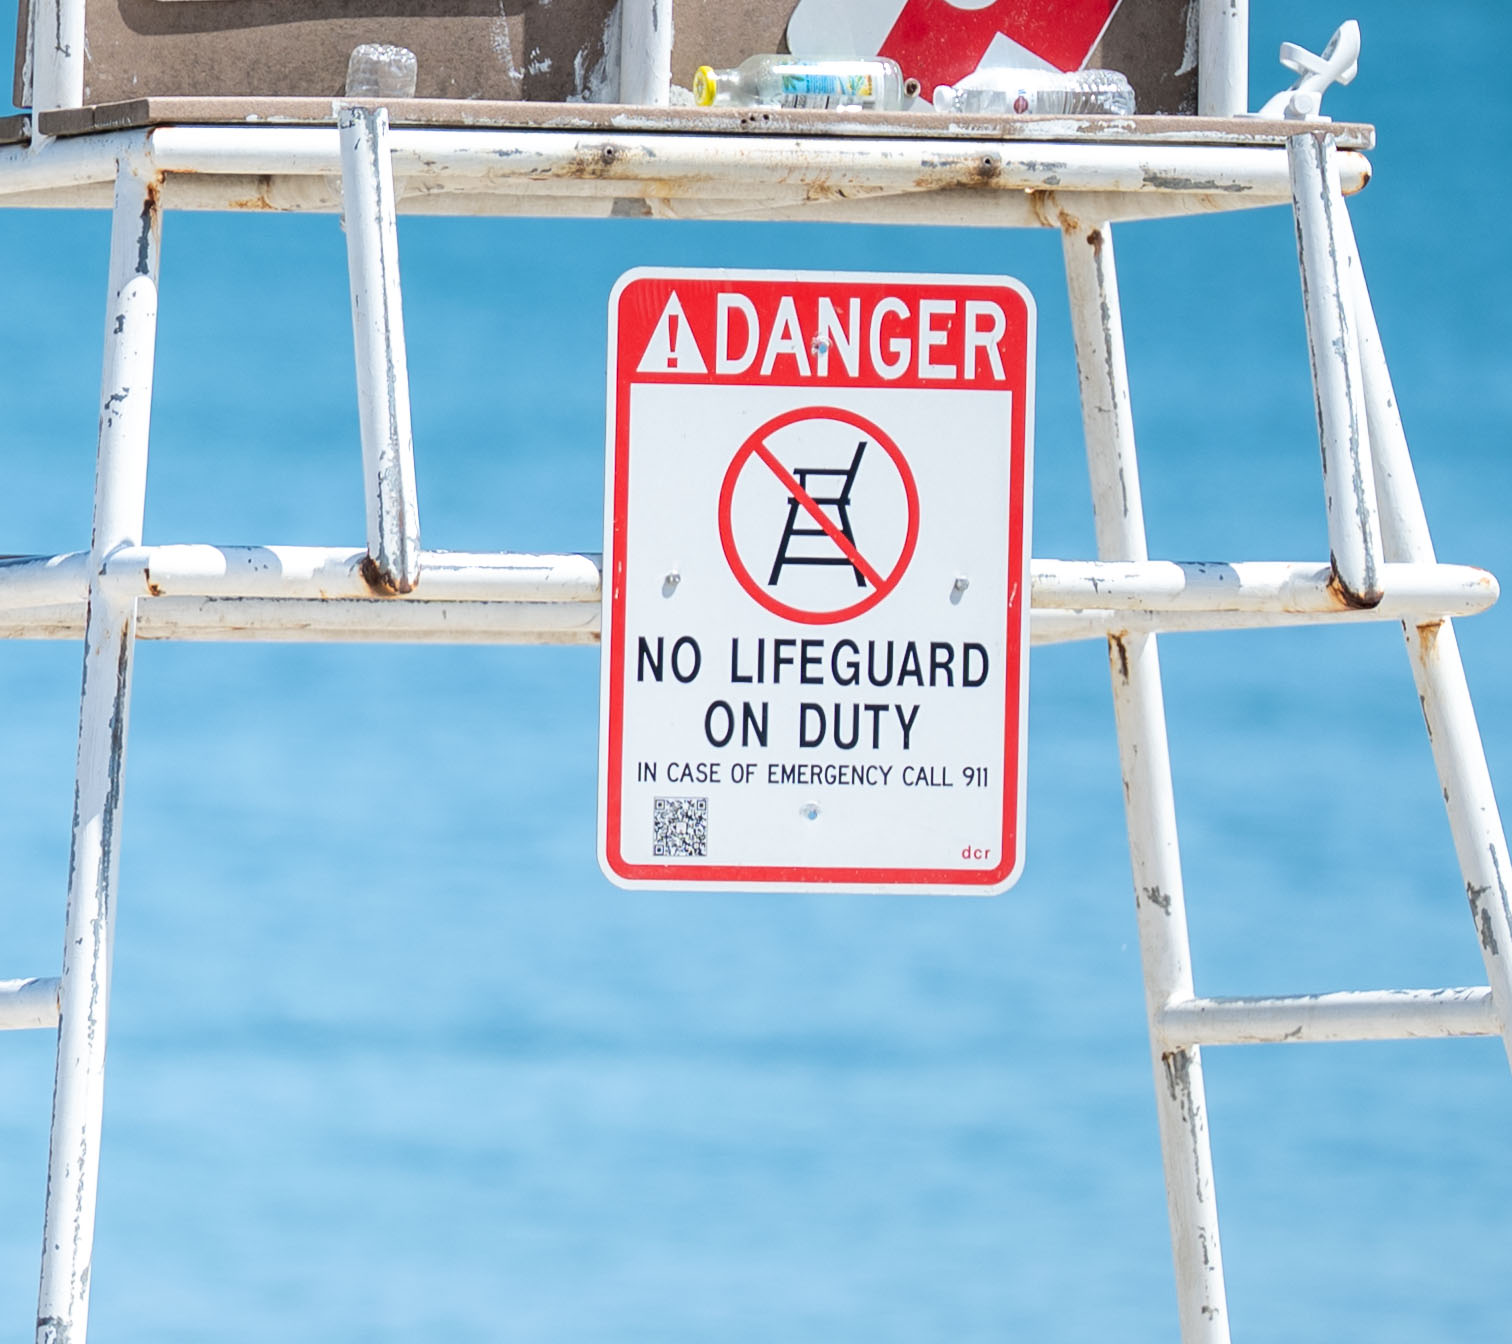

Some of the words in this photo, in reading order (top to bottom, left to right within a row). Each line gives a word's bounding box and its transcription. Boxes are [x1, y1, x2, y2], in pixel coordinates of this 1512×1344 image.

[714, 291, 1008, 381] DANGER
[637, 635, 702, 684] NO
[731, 637, 989, 688] LIFEGUARD
[704, 700, 769, 748] ON
[799, 702, 920, 750] DUTY
[638, 762, 657, 782] IN
[667, 762, 721, 783] CASE
[731, 763, 758, 784] OF
[768, 763, 893, 786] EMERGENCY
[902, 765, 953, 787] CALL
[962, 766, 988, 787] 911
[961, 845, 990, 860] dcr
